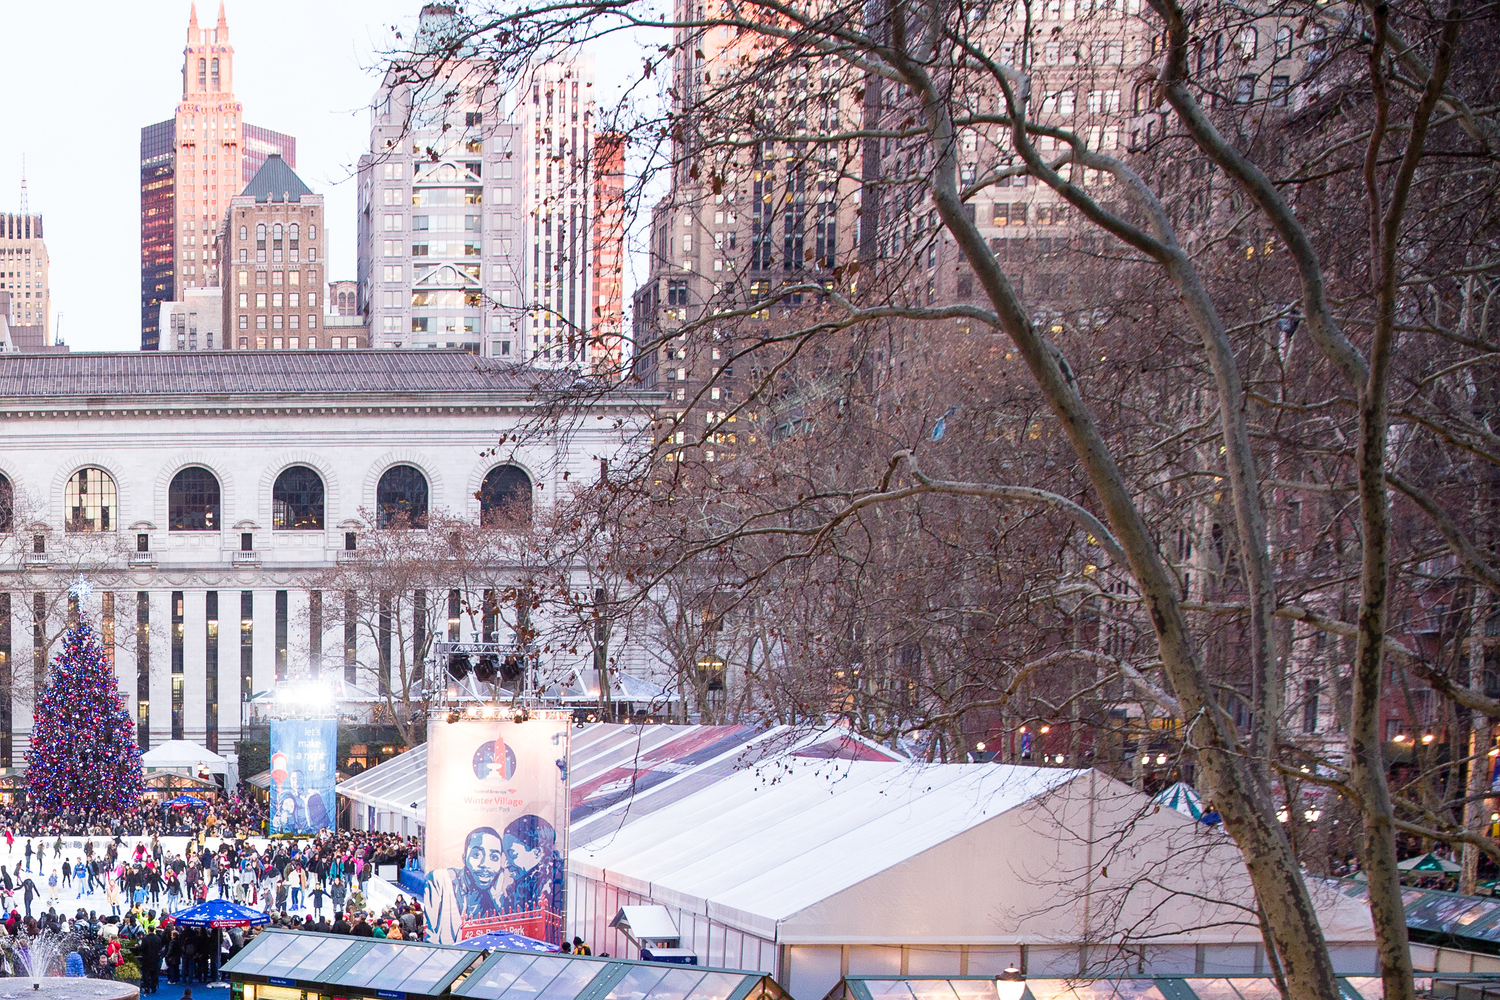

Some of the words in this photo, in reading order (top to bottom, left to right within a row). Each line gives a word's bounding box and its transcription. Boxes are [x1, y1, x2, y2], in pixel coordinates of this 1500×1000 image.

[298, 739, 321, 748] make
[304, 752, 324, 762] night
[308, 762, 316, 771] of
[464, 797, 492, 805] Winter
[494, 797, 523, 807] Village
[465, 930, 474, 939] 42
